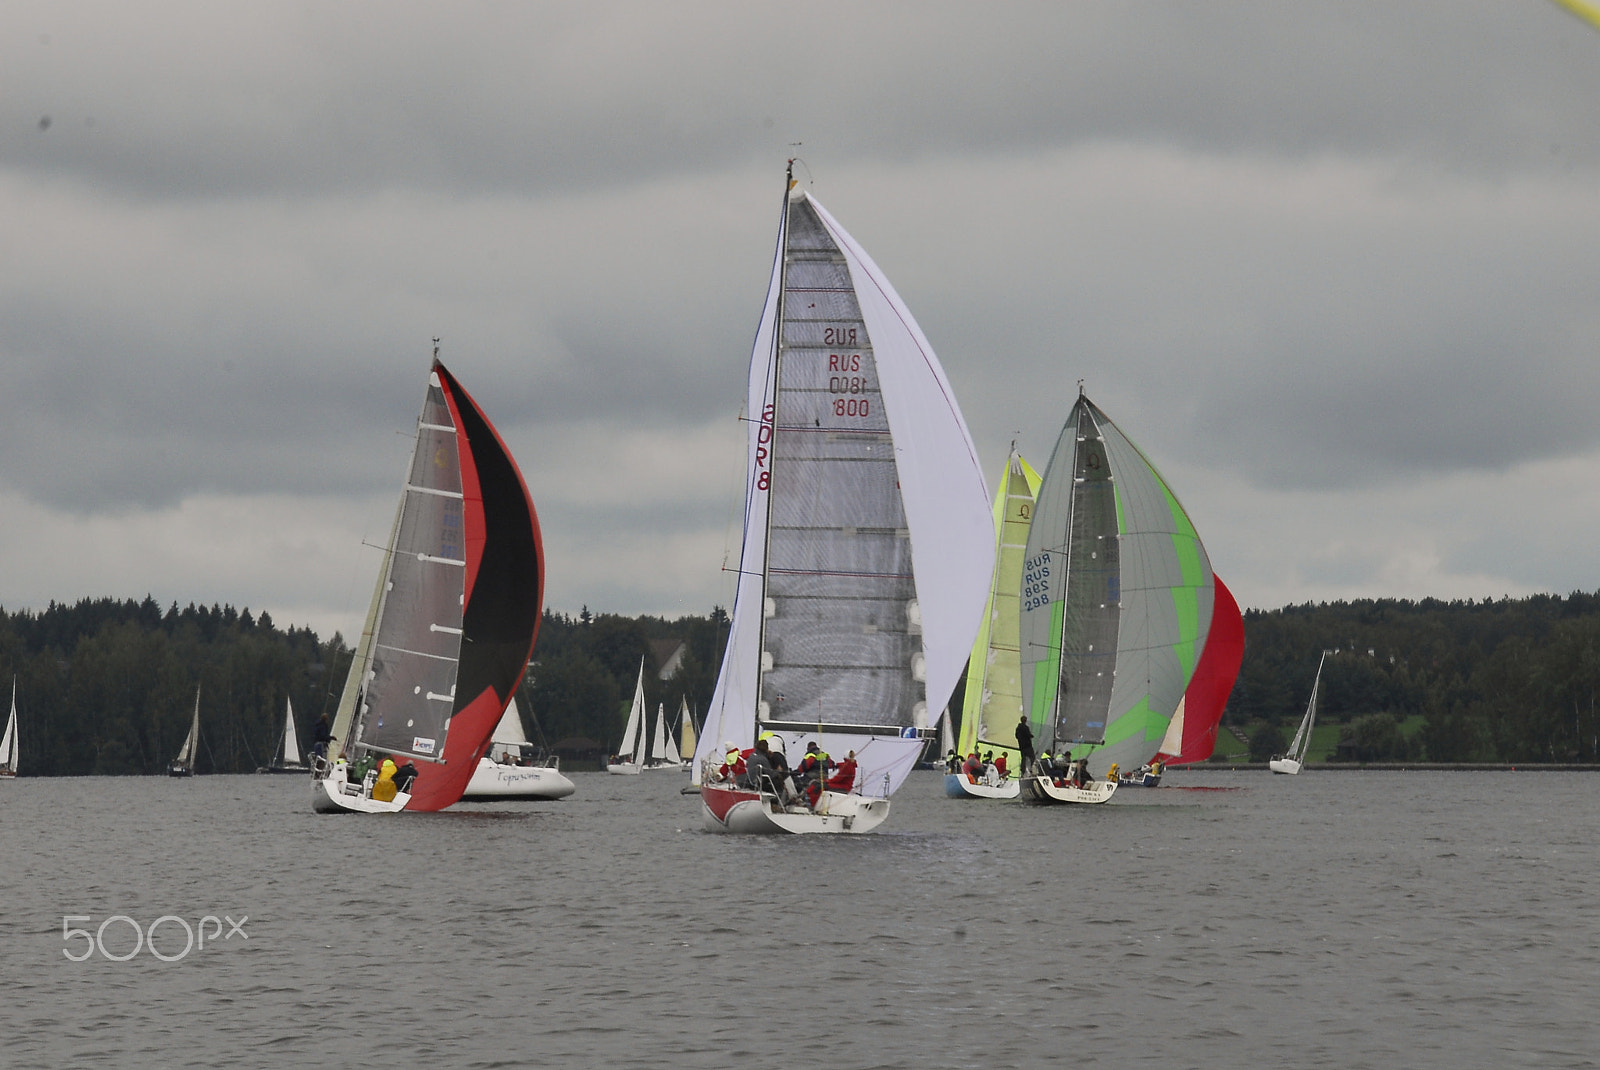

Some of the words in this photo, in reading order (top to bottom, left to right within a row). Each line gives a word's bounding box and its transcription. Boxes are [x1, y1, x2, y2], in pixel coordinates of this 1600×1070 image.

[829, 354, 860, 372] RUS
[1025, 567, 1050, 585] RUS
[1024, 594, 1049, 612] 298
